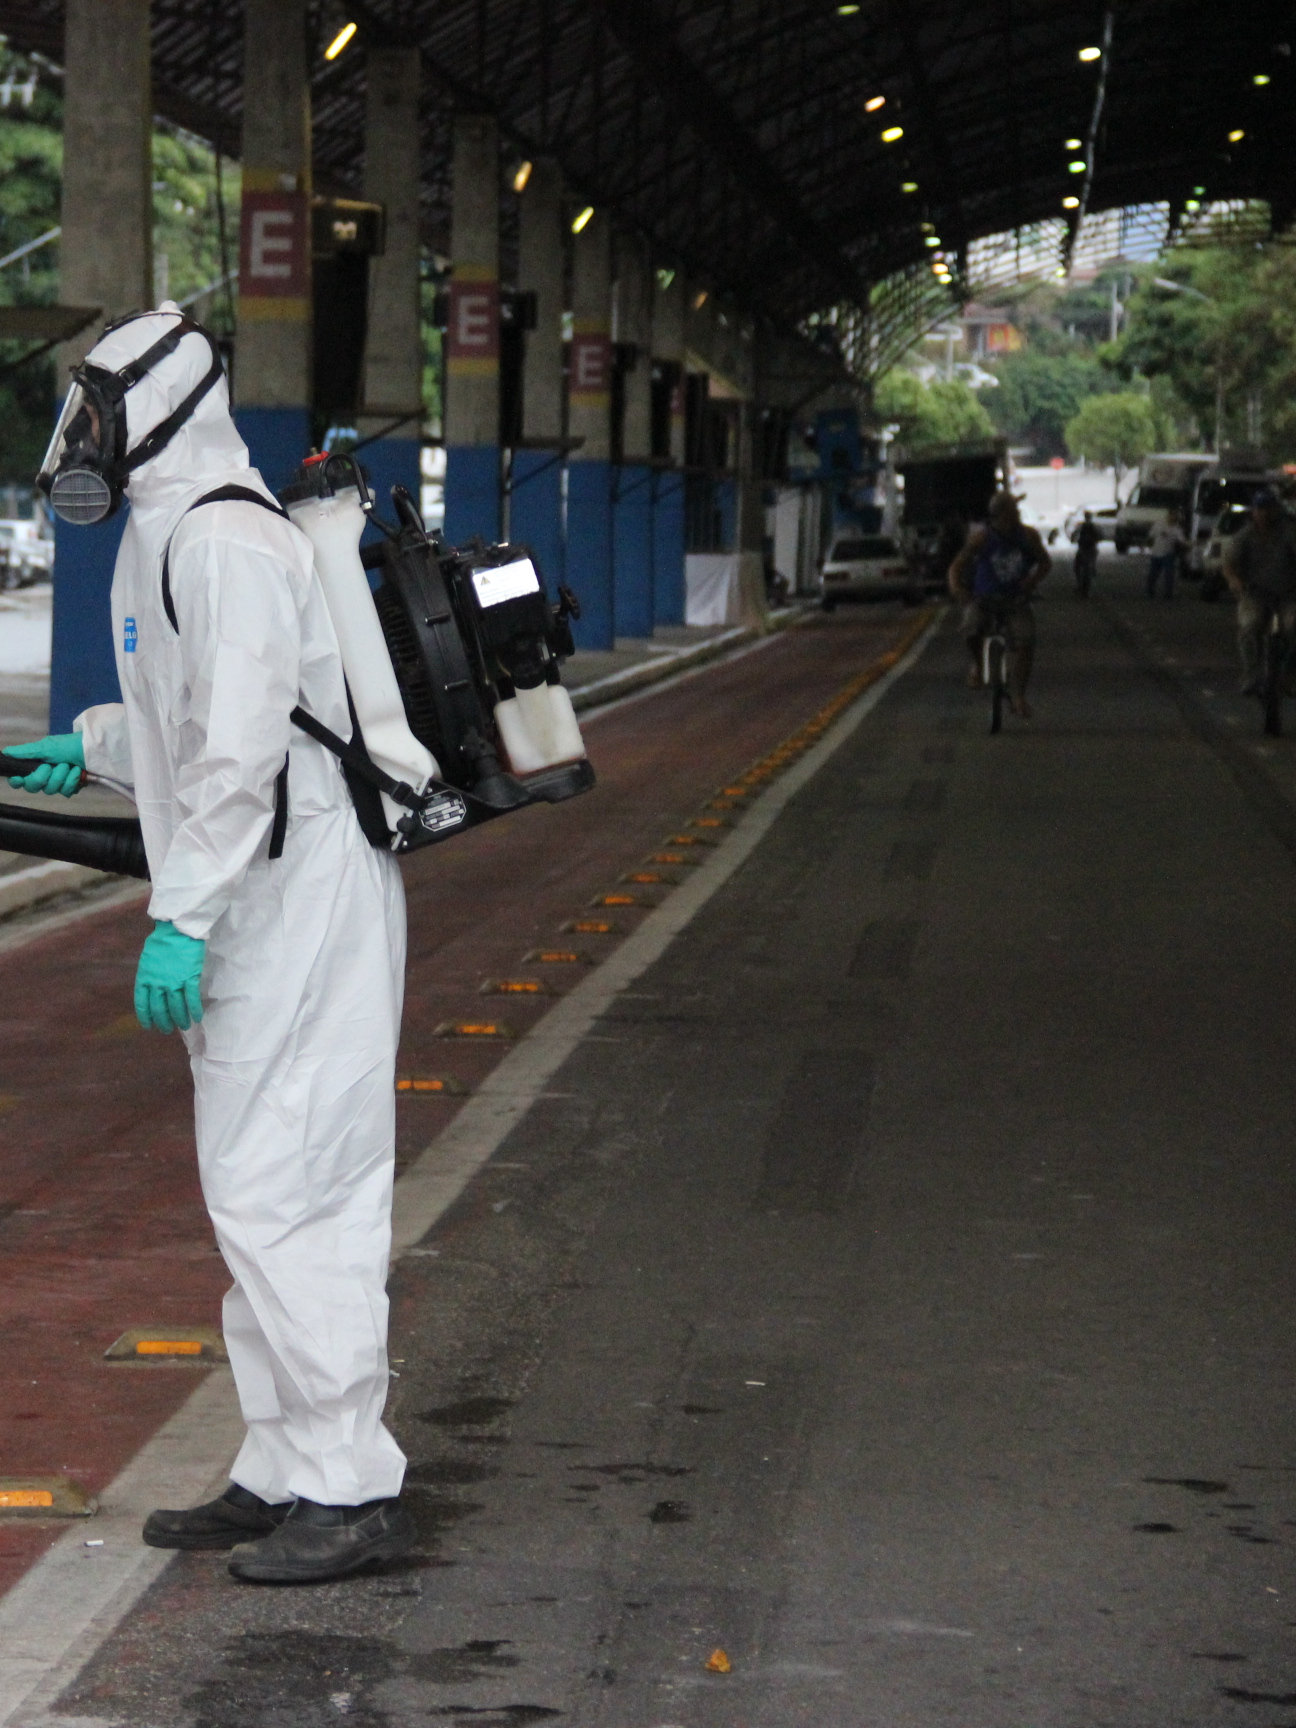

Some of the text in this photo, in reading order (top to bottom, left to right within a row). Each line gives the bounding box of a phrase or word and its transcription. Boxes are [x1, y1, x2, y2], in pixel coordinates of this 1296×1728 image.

[251, 210, 293, 277] E
[458, 295, 488, 344] E
[579, 345, 603, 384] E
